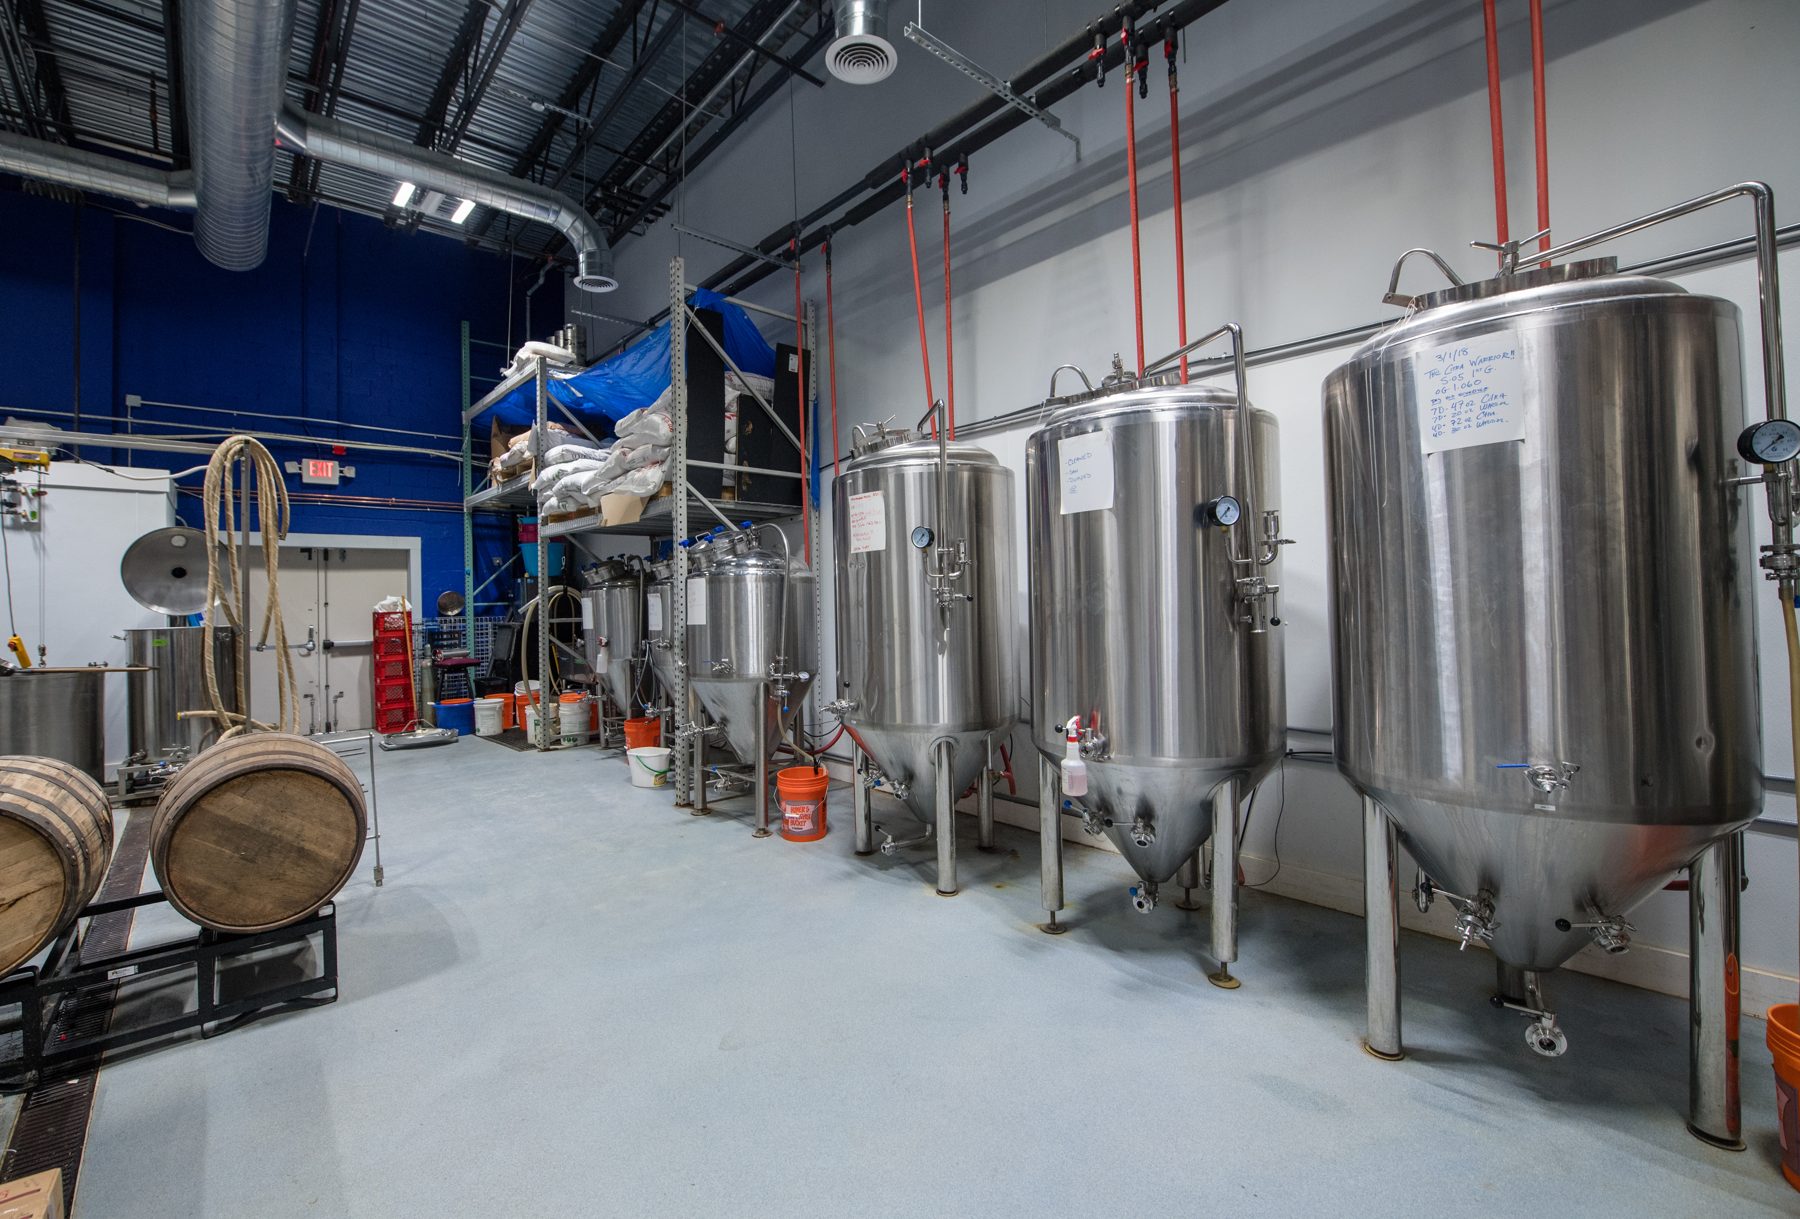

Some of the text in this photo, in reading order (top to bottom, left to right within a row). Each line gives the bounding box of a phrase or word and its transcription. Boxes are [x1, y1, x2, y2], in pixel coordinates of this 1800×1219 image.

[1435, 346, 1469, 362] 3/1/18
[1453, 379, 1482, 391] 1.060
[309, 460, 334, 478] EXIT
